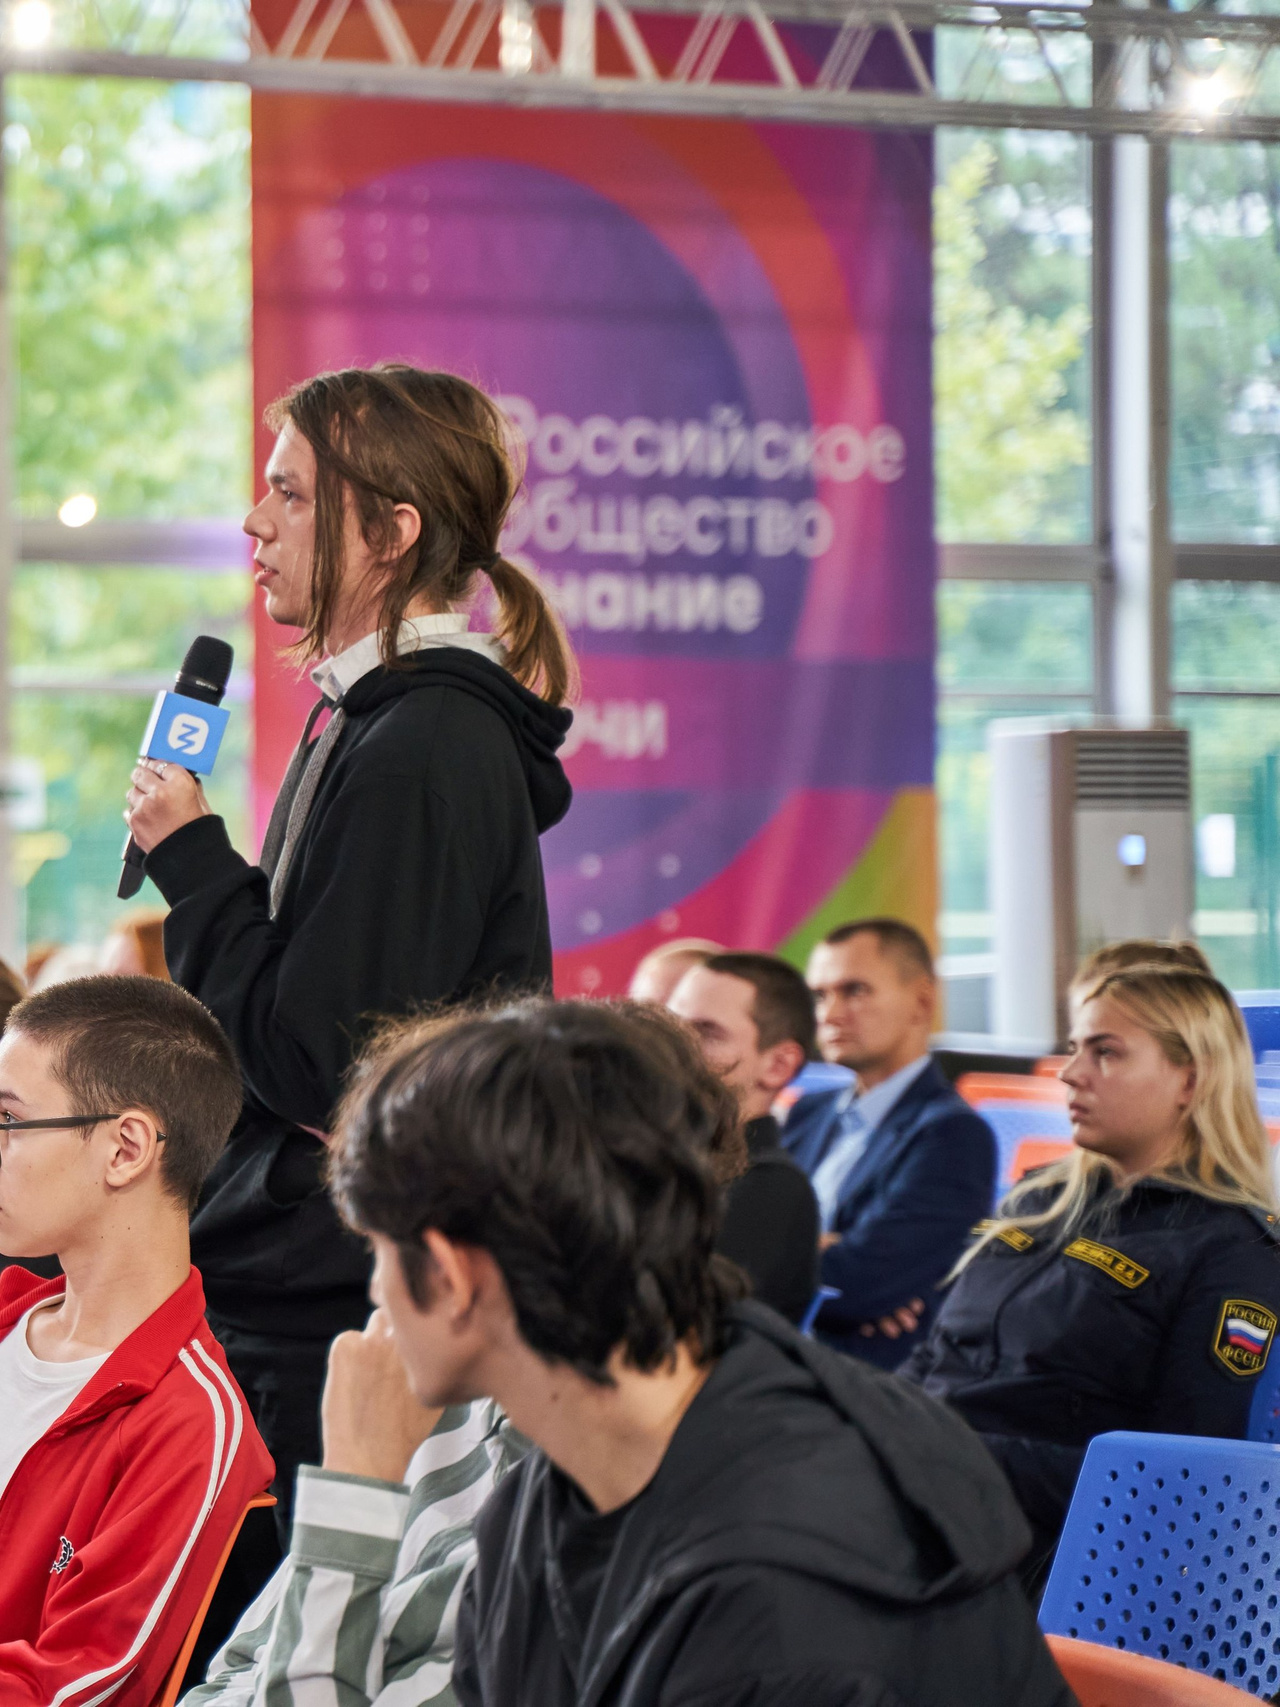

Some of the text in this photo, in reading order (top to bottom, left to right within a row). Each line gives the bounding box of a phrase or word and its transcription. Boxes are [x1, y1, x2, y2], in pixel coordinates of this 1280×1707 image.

[503, 555, 764, 633] нание
[1227, 1304, 1273, 1330] РОССИЯ
[1222, 1344, 1261, 1369] ФССП
